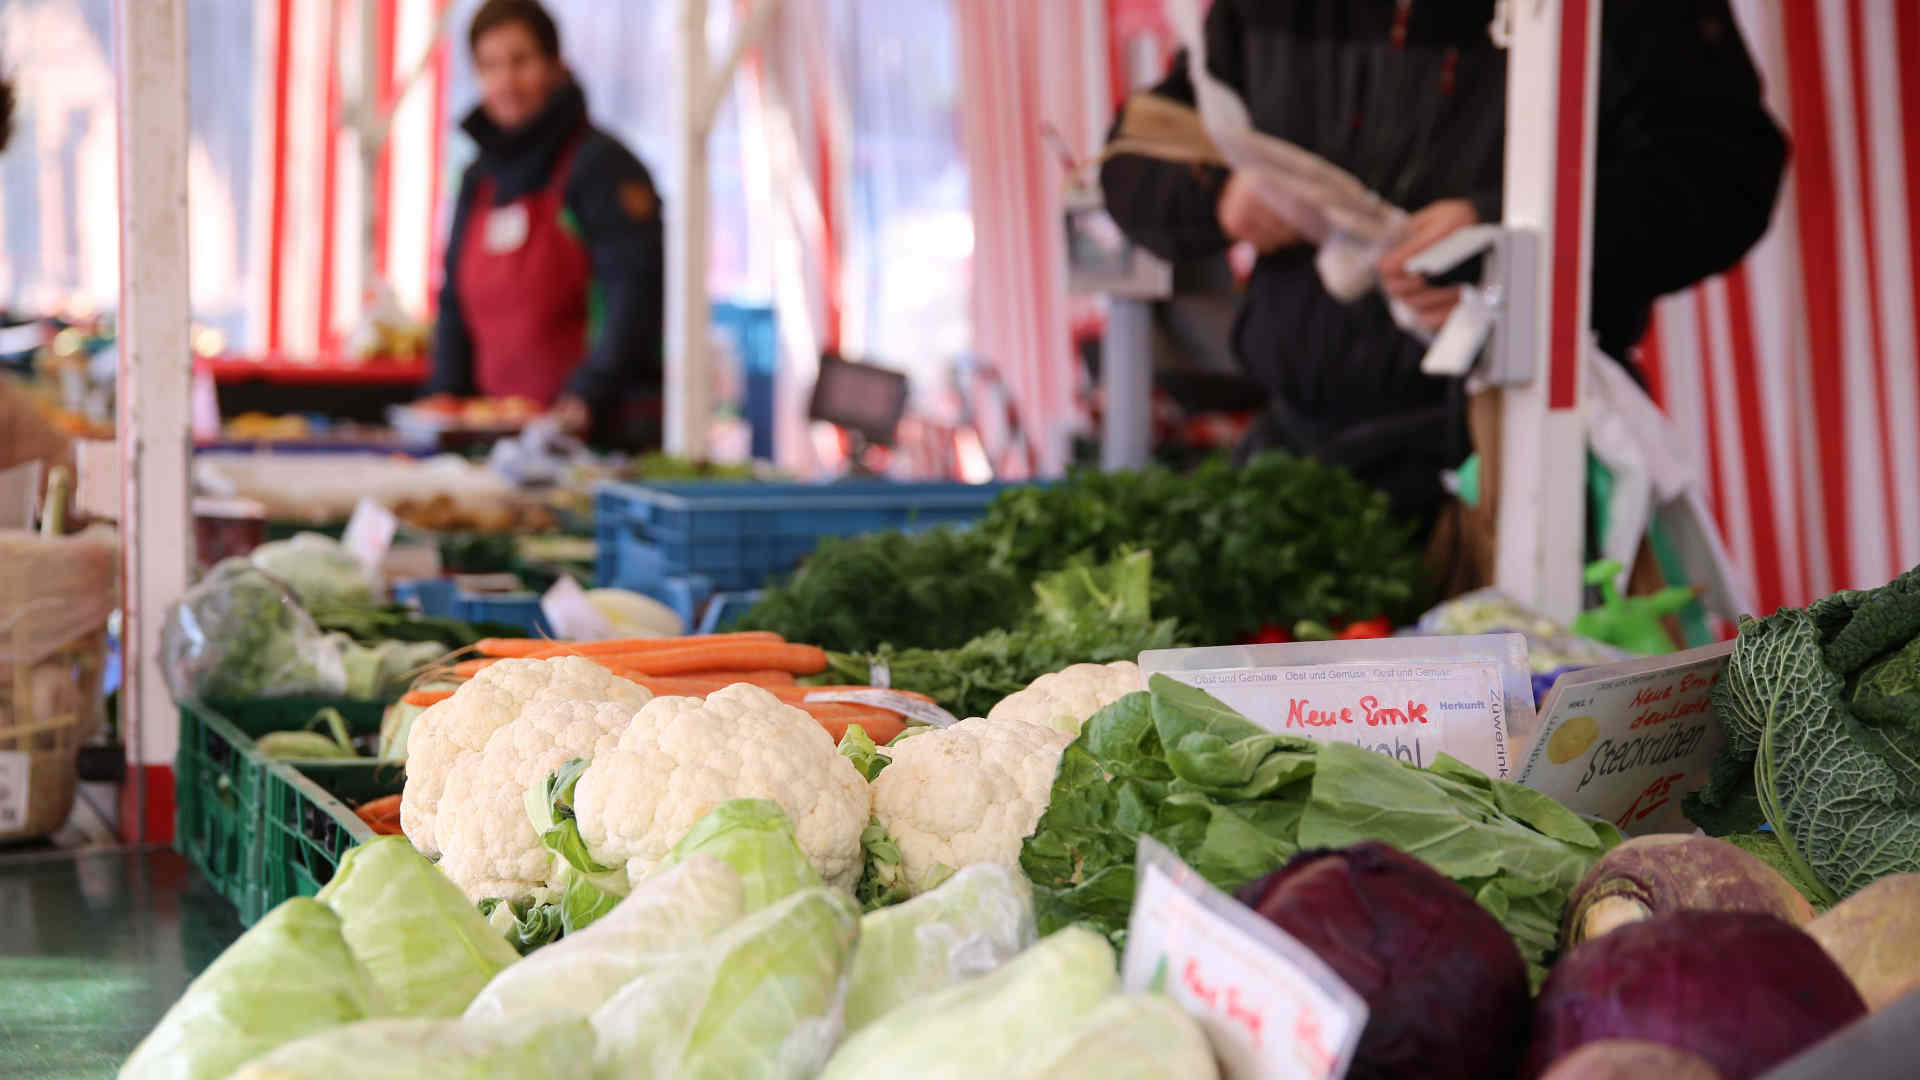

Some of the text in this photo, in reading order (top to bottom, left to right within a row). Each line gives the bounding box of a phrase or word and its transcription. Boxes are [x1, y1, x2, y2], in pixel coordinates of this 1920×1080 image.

[1219, 672, 1236, 683] und
[1284, 670, 1307, 681] Obst
[1310, 670, 1326, 680] und
[1286, 698, 1353, 729] Neue
[1439, 700, 1486, 711] Herkunft
[1489, 688, 1509, 778] Zuwerink
[1576, 720, 1707, 793] Steckrüben
